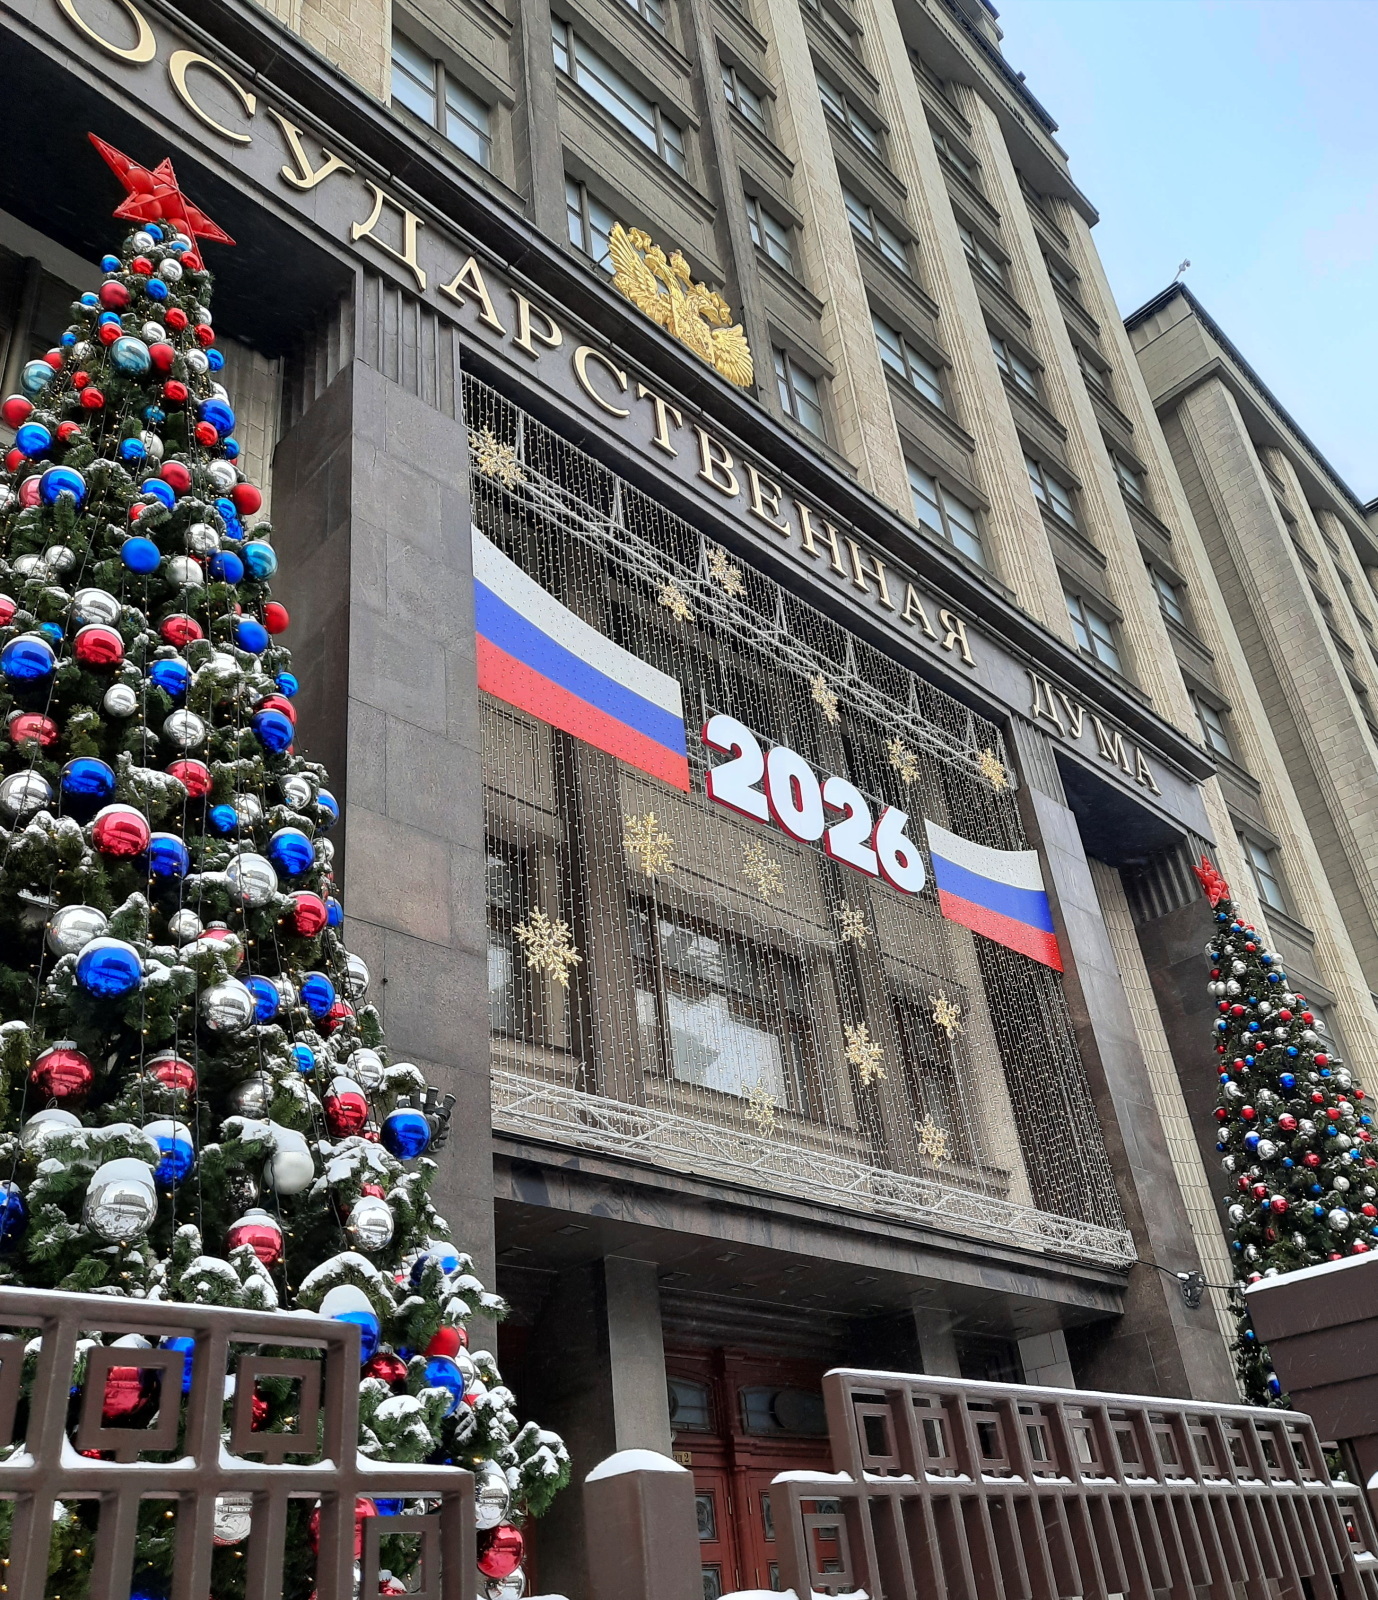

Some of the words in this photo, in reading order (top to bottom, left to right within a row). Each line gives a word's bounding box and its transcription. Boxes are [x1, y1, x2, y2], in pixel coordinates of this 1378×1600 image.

[1026, 668, 1162, 796] ДУМА
[702, 715, 926, 894] 2026
[683, 1452, 690, 1463] 2
